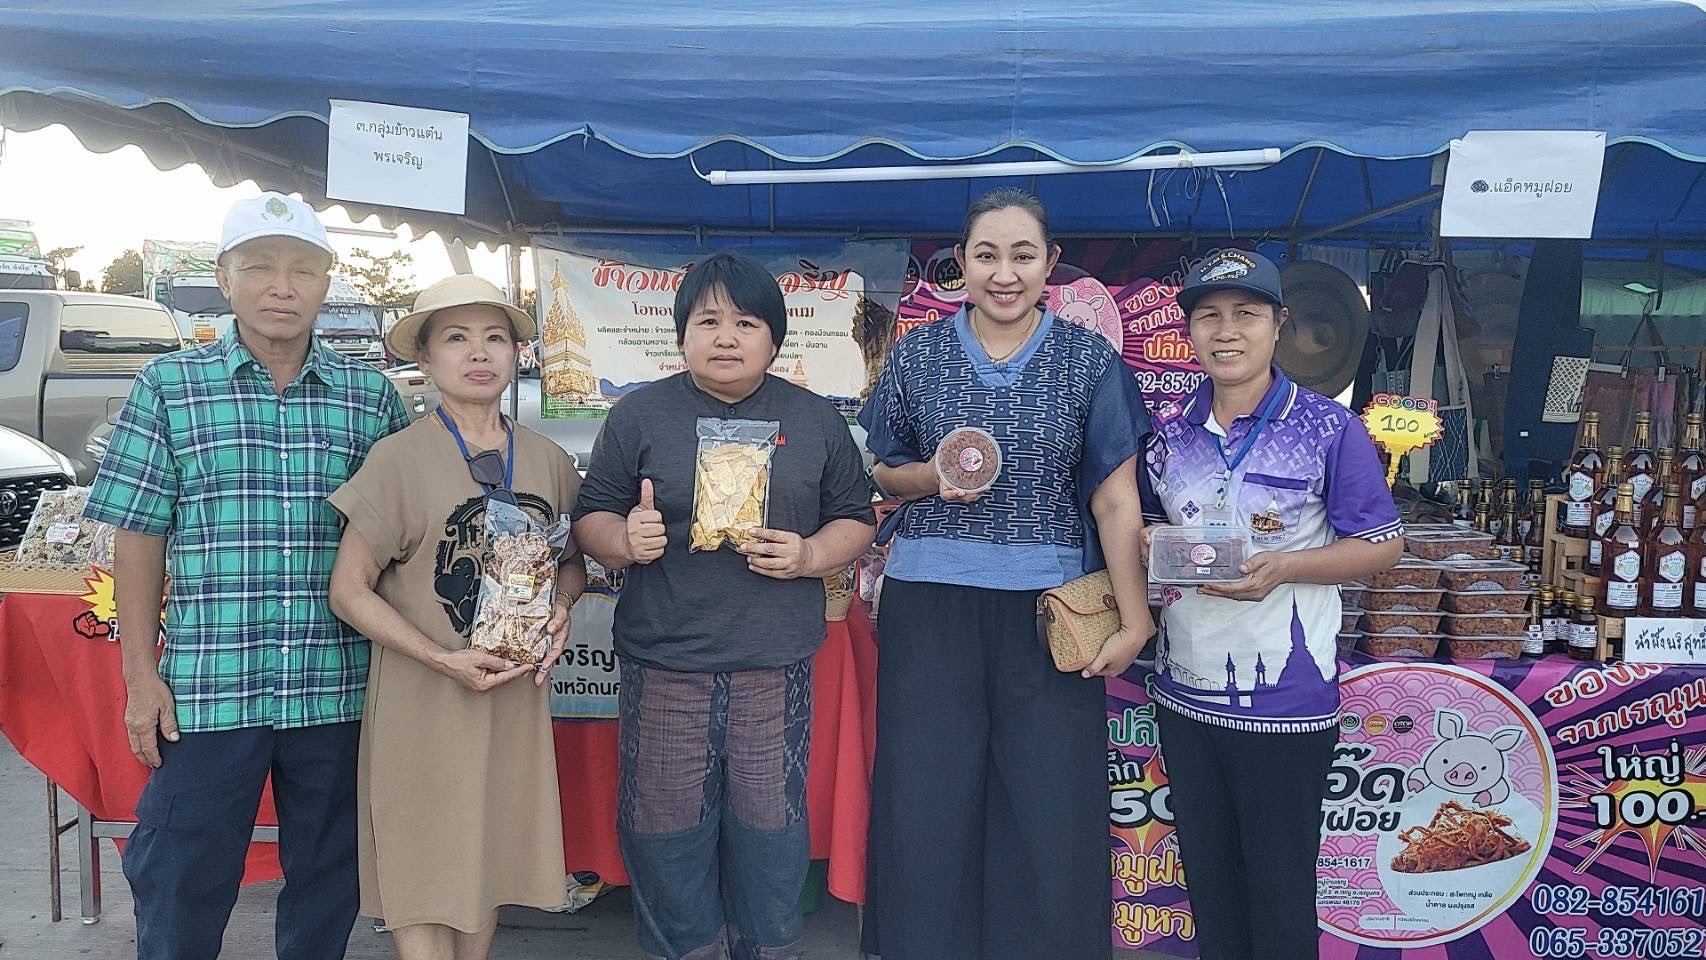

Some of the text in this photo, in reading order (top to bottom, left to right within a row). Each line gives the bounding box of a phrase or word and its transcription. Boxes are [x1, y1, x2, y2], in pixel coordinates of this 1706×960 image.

[373, 151, 424, 170] พรเจริญ
[1380, 414, 1420, 433] 100
[1597, 738, 1681, 785] ใหญ่
[1316, 857, 1372, 869] 854-1617
[1530, 926, 1706, 960] 065-337052
